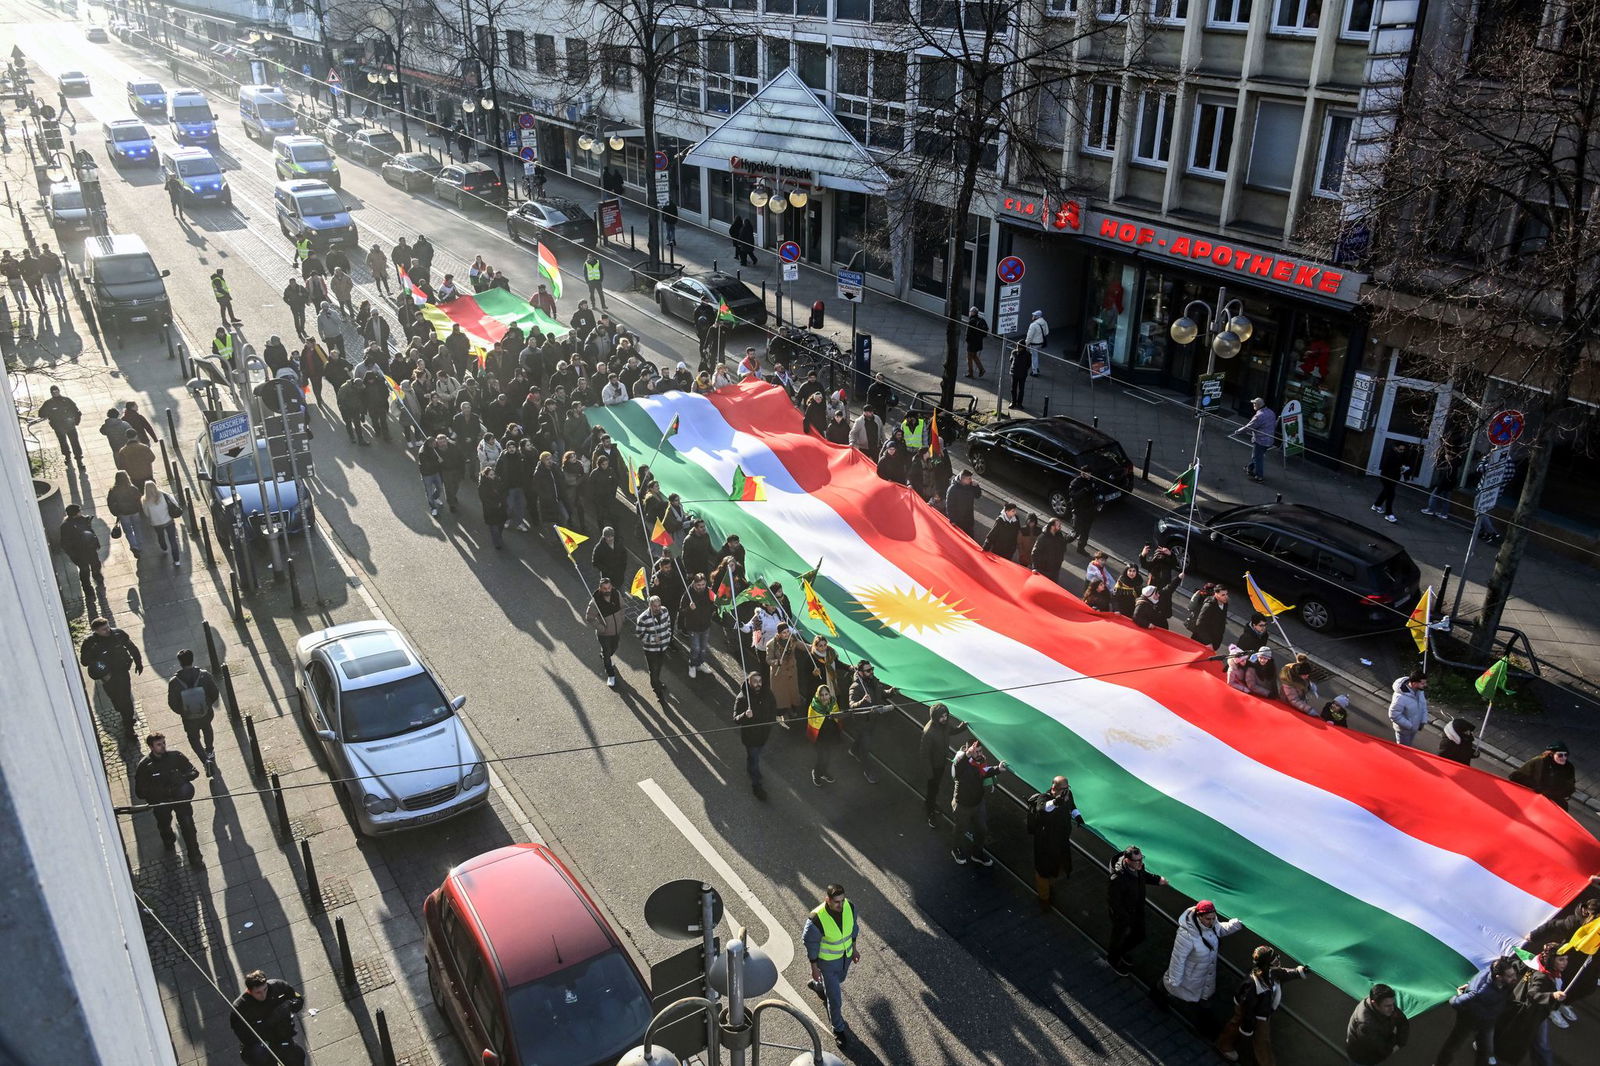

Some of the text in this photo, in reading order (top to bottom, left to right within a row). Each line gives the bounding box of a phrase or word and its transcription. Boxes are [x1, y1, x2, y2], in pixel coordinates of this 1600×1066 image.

[741, 158, 812, 179] HypoVerinsbank
[212, 416, 247, 433] PARKSCHEIN-
[219, 425, 243, 440] AUTOMAT
